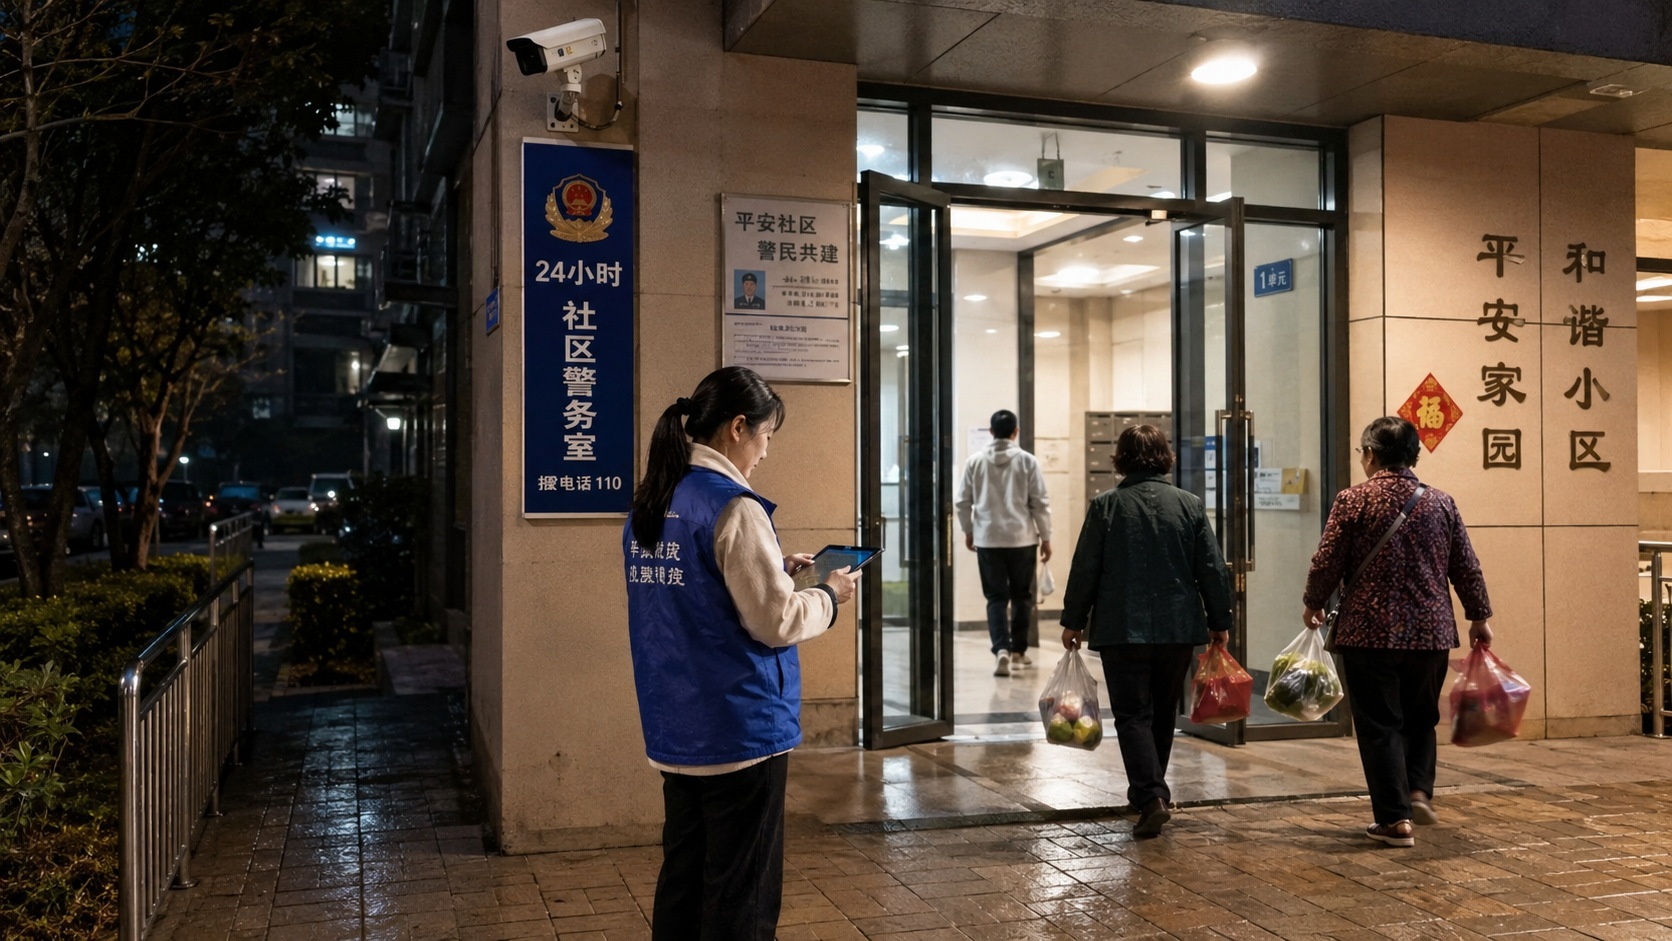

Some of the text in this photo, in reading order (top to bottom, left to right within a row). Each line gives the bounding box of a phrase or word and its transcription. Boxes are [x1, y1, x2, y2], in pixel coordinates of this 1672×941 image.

[735, 211, 817, 235] 平安社区
[757, 240, 839, 264] 警民共建
[535, 260, 623, 287] 24小时
[1476, 233, 1527, 470] 平安家园
[1562, 242, 1612, 472] 和谐小区
[562, 300, 598, 461] 社区警务室
[1416, 395, 1445, 429] 福
[595, 476, 622, 490] 110
